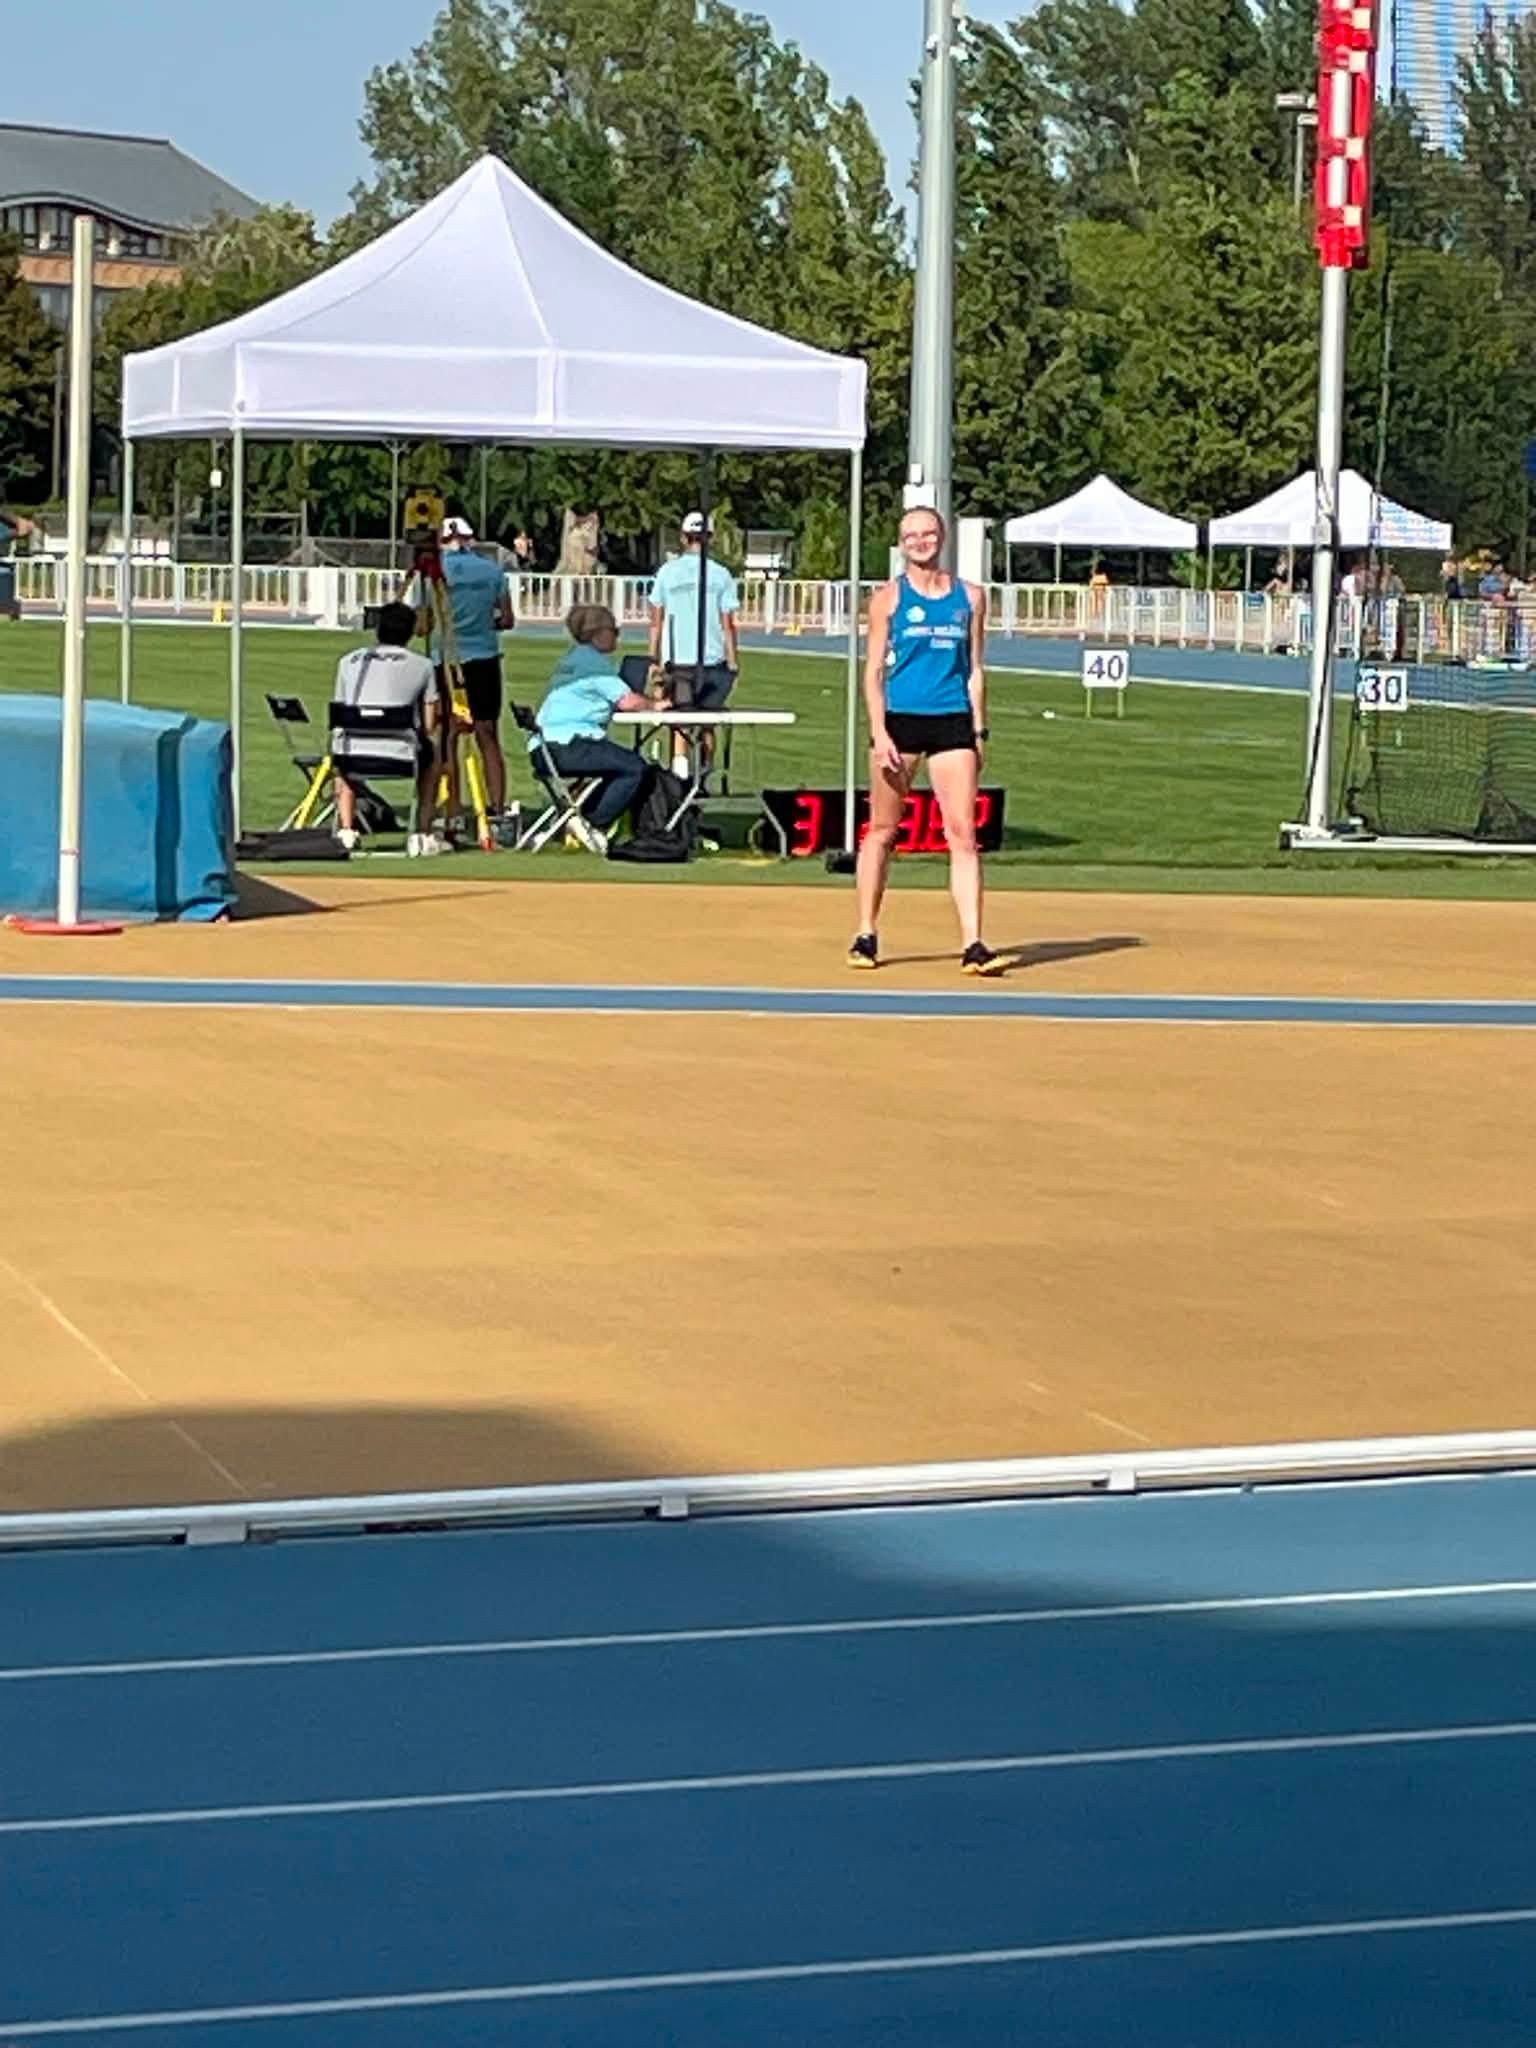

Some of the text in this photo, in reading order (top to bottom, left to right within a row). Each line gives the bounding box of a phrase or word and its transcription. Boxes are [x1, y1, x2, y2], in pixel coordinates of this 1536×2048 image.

[1087, 655, 1124, 681] 40
[1363, 675, 1401, 703] 30
[792, 796, 822, 856] 3
